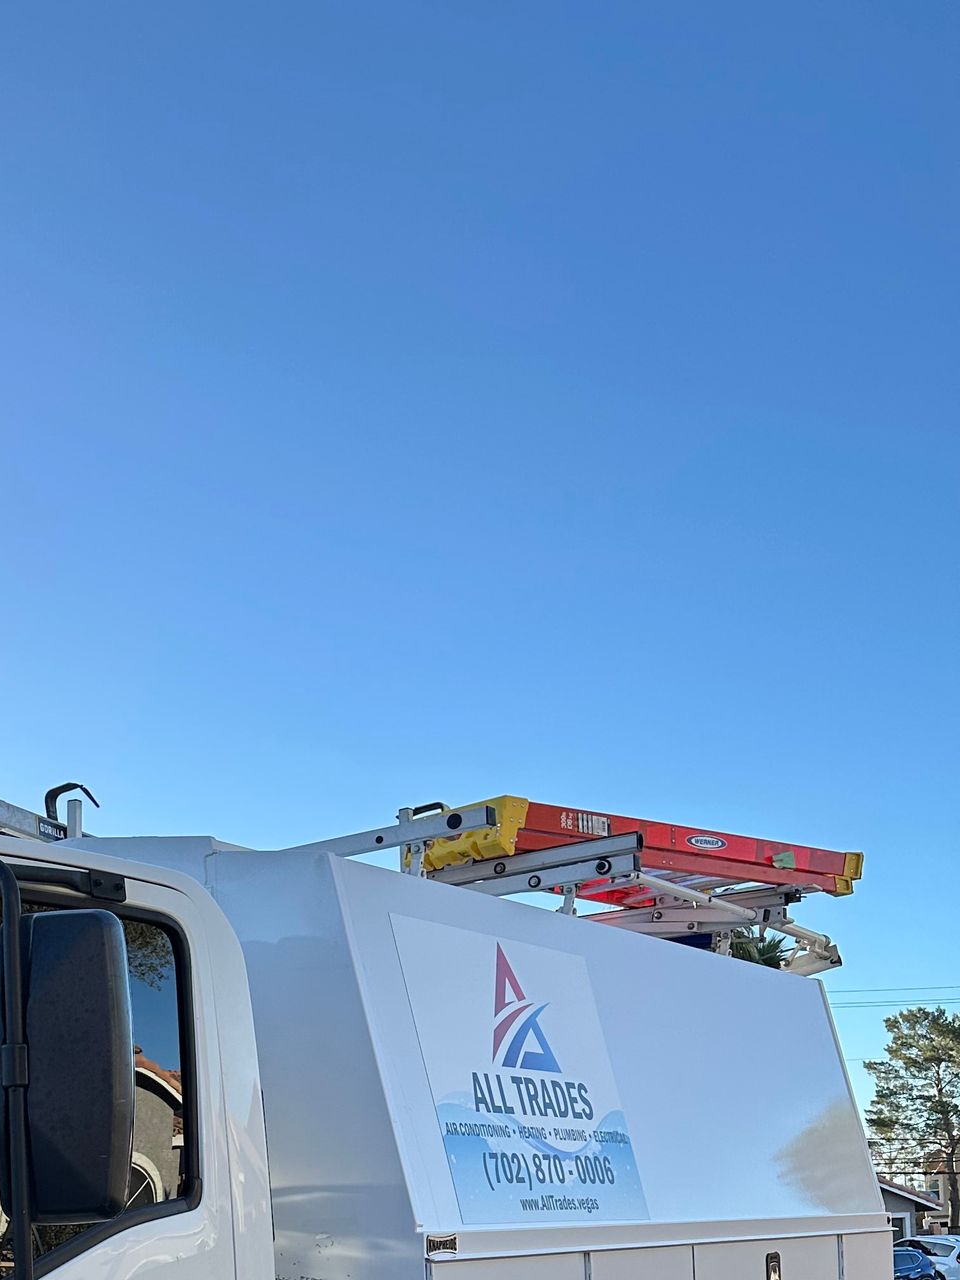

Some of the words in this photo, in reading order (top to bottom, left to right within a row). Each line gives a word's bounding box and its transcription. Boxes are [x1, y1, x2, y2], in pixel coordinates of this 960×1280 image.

[39, 822, 65, 839] GORILLA
[694, 838, 720, 846] WERNER
[472, 1071, 515, 1115] ALL
[511, 1075, 594, 1120] TRADES
[445, 1122, 458, 1137] AIR
[458, 1123, 511, 1138] CONDITIONING
[517, 1126, 547, 1140] HEATING
[553, 1127, 588, 1142] PLUMBING
[482, 1152, 533, 1191] (702)
[519, 1194, 600, 1213] www.AllTrades.vegas
